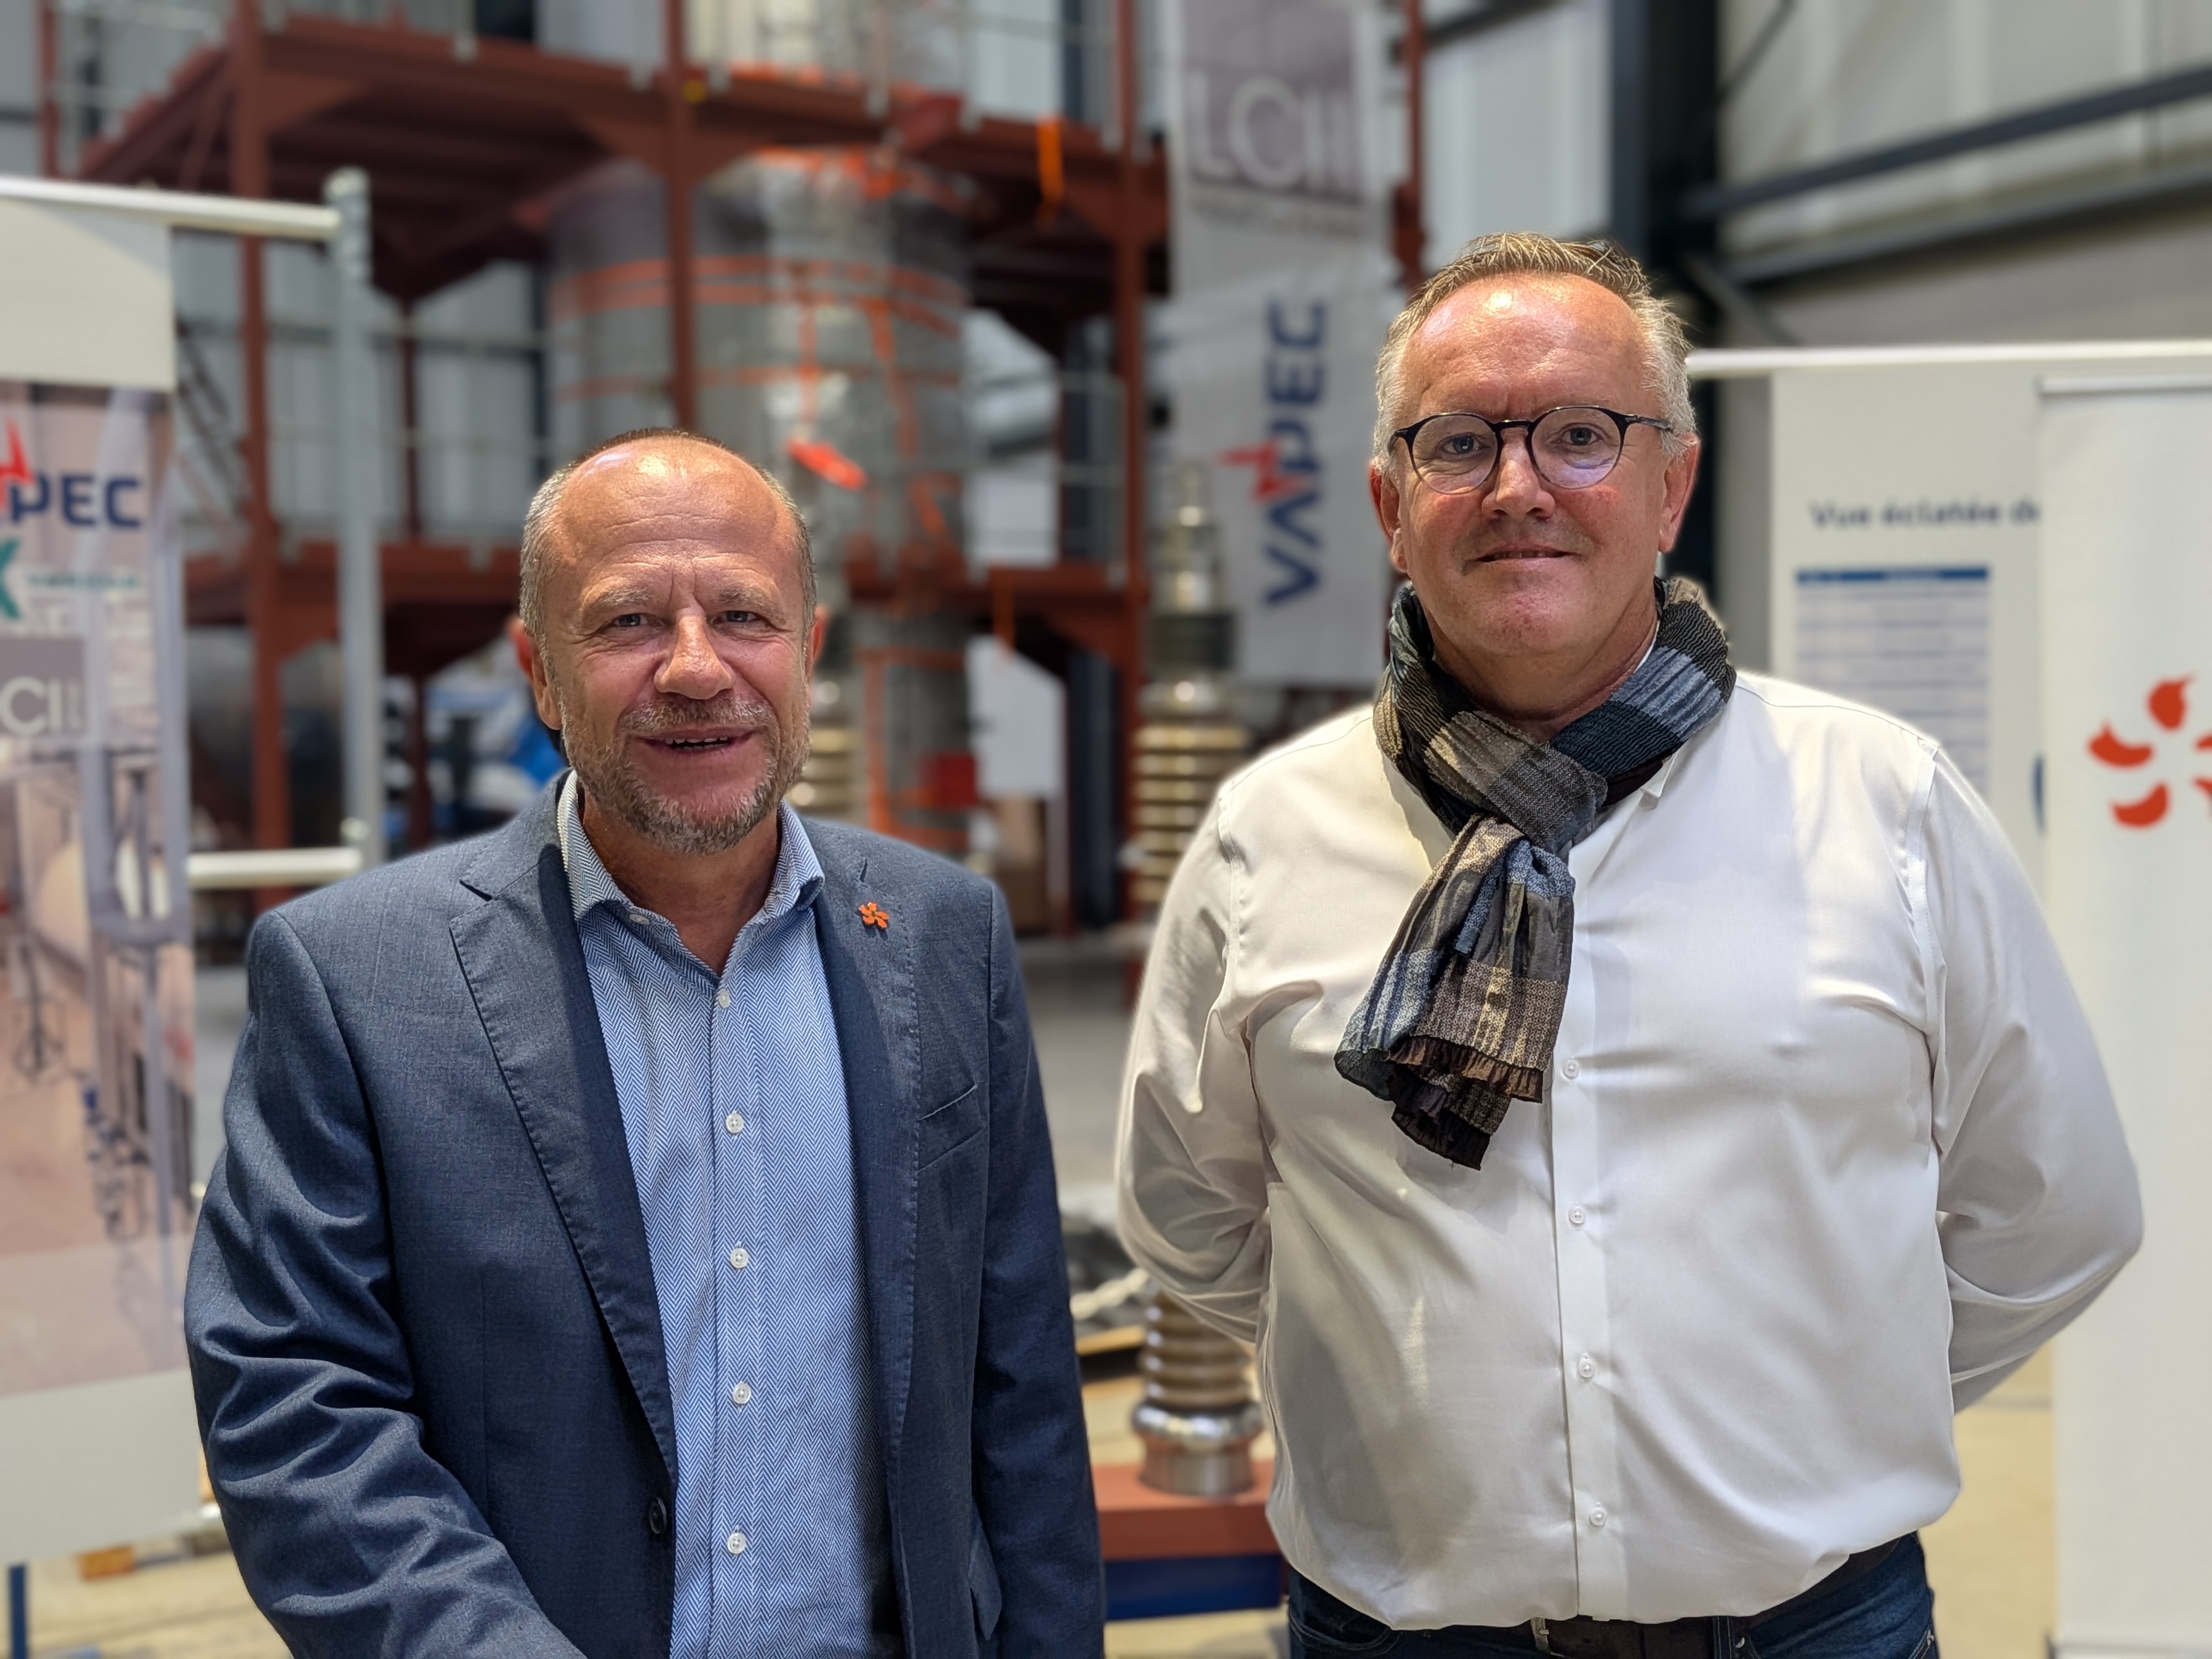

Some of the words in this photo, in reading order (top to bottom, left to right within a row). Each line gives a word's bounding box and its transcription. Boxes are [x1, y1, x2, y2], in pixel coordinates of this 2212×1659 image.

[1264, 296, 1327, 607] VAPEC
[2, 473, 142, 529] PEC
[1808, 501, 1870, 528] Vue
